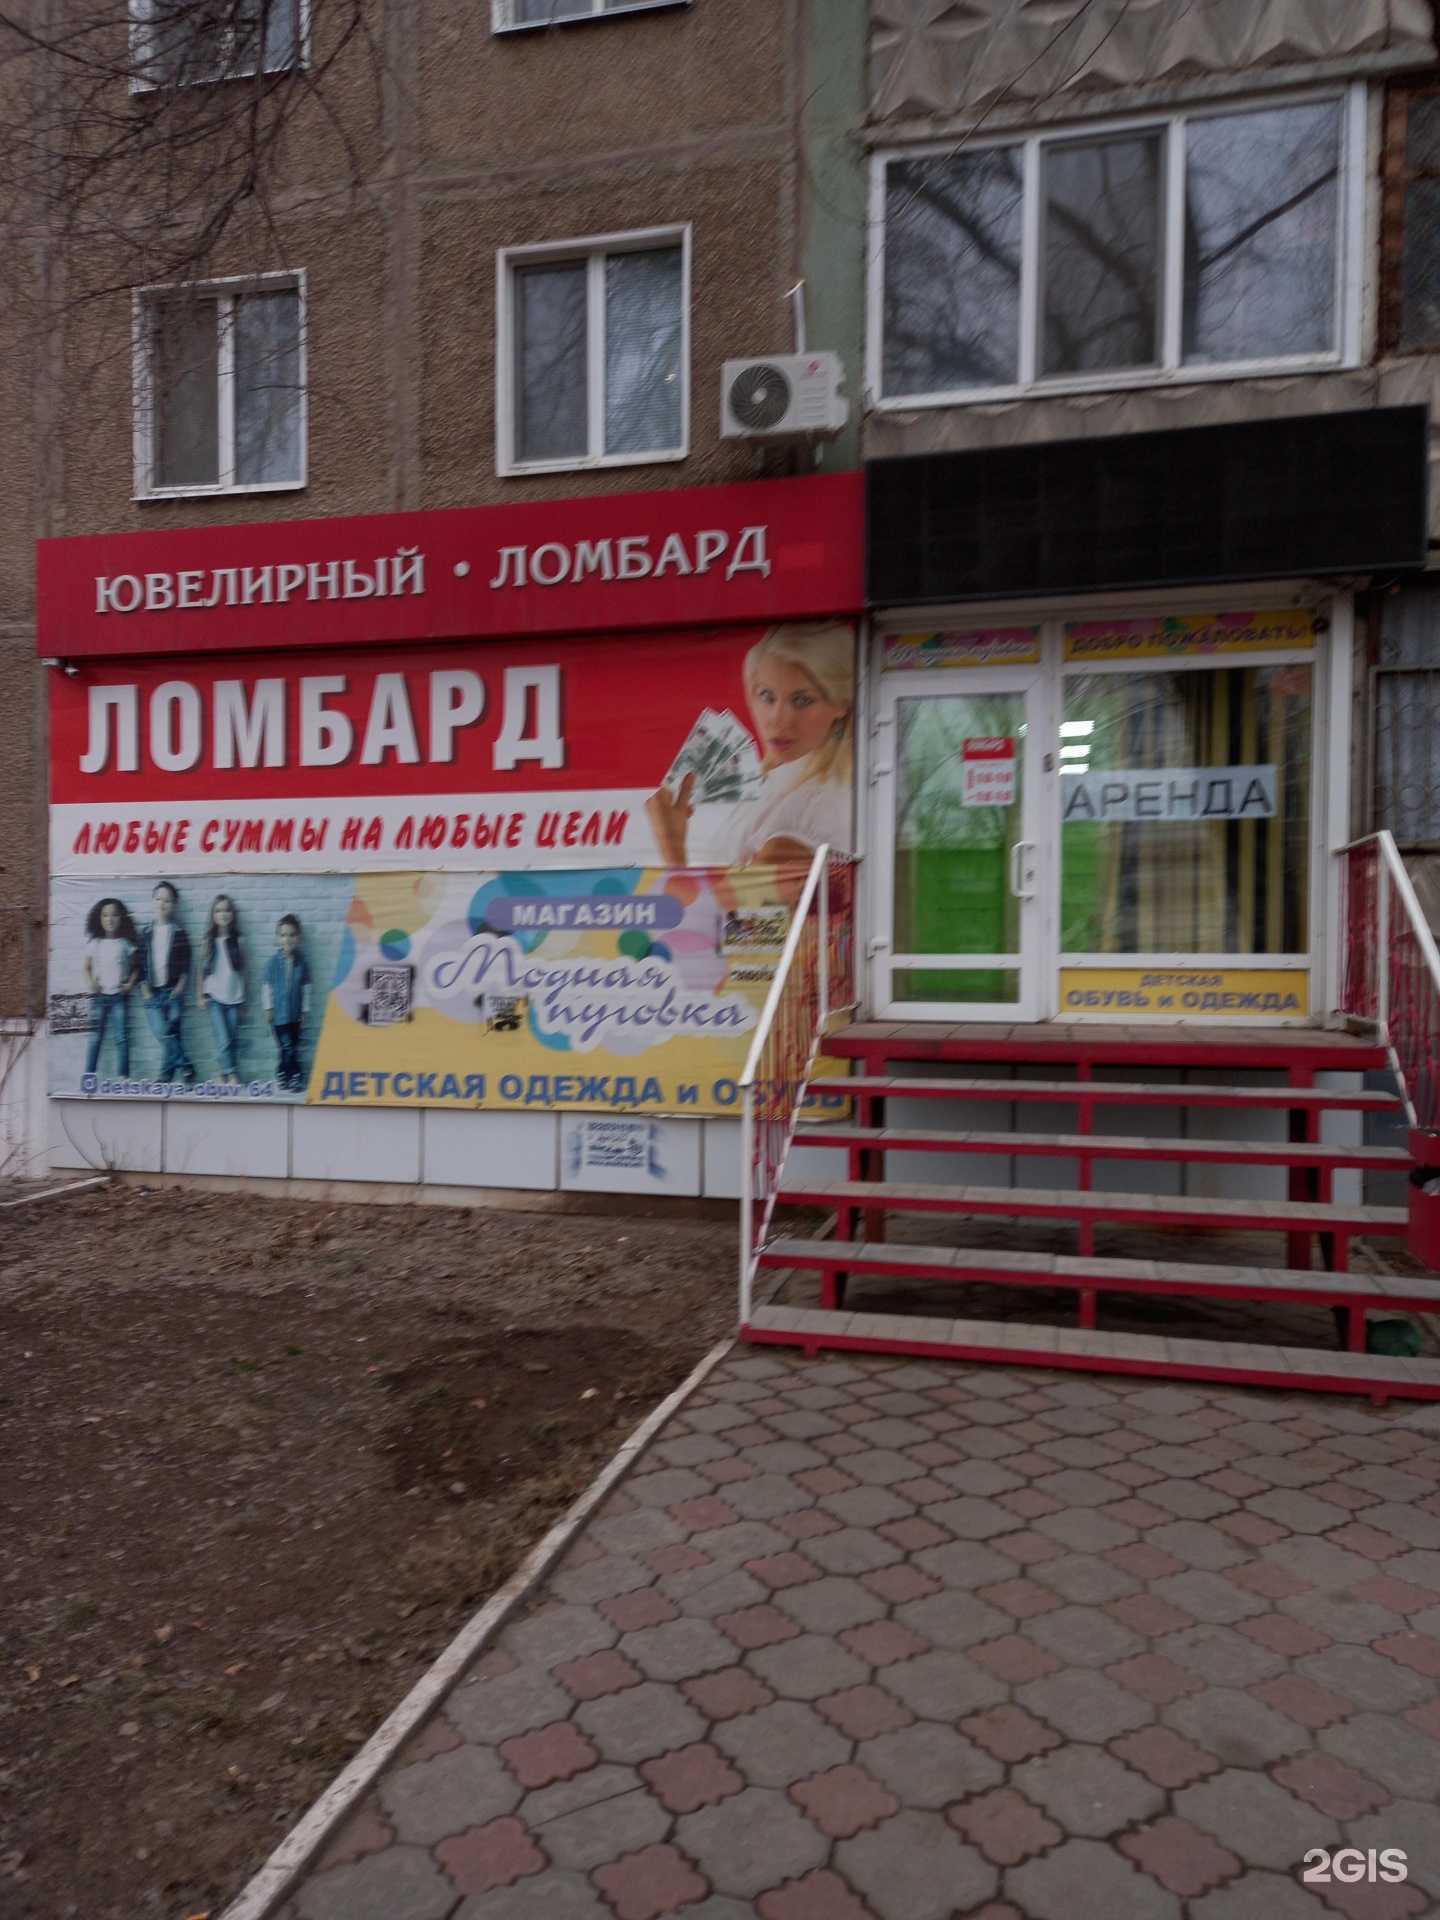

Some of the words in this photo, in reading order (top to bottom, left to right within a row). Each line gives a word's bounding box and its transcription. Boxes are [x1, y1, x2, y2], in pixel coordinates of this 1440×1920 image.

[94, 545, 426, 614] ЮВЕЛИРНЫЙ
[489, 524, 772, 590] ЛОМБАРД
[79, 663, 566, 774] ЛОМБАРД
[1063, 776, 1274, 820] АРЕНДА
[73, 818, 191, 854] ЛЮБЫЕ
[200, 817, 329, 853] СУММЫ
[341, 815, 384, 851] НА
[394, 811, 527, 850] ЛЮБЫЕ
[535, 808, 630, 848] ЦЕЛИ
[512, 903, 656, 927] МАГАЗИН
[433, 943, 671, 1008] Модная
[1139, 974, 1224, 988] ДЕТСКАЯ
[548, 985, 749, 1043] пуговка
[1067, 990, 1149, 1007] ОБУВЬ
[1183, 991, 1301, 1012] ОДЕЖДА
[321, 1071, 487, 1101] ДЕТСКАЯ
[500, 1075, 664, 1107] ОДЕЖДА
[677, 1084, 698, 1105] и
